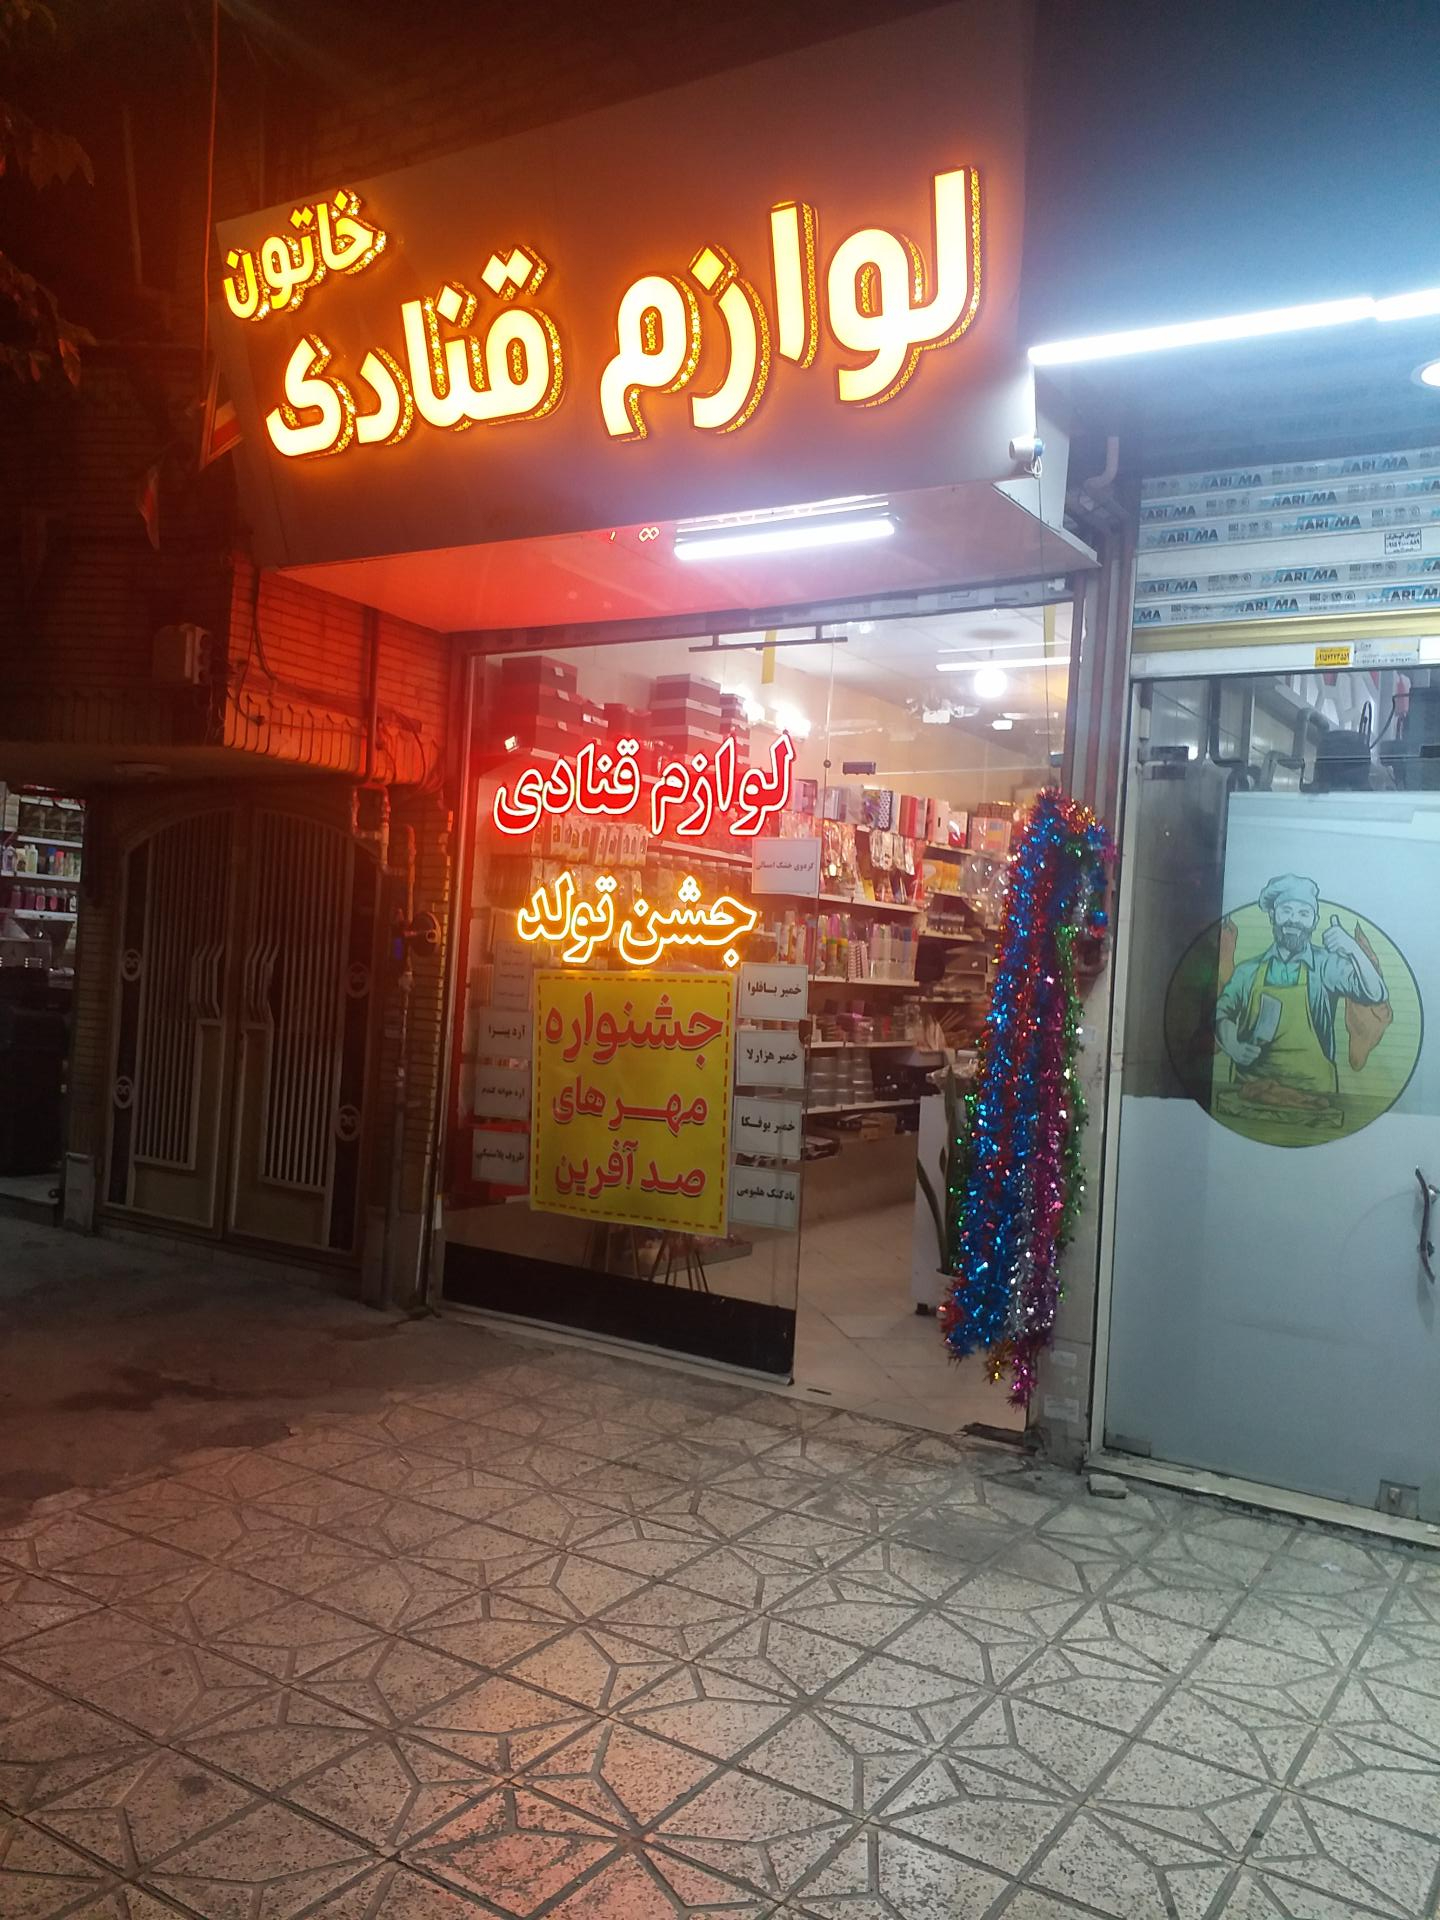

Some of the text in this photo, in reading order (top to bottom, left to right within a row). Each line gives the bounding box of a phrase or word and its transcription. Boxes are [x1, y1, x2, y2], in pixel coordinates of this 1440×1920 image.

[221, 187, 388, 322] خاتون
[264, 163, 981, 459] لوازم قنادی
[492, 730, 796, 837] لوازم قنادی
[516, 869, 759, 968] جشن تولد
[544, 990, 725, 1069] جشنواره
[554, 1139, 708, 1199] صد آفرین
